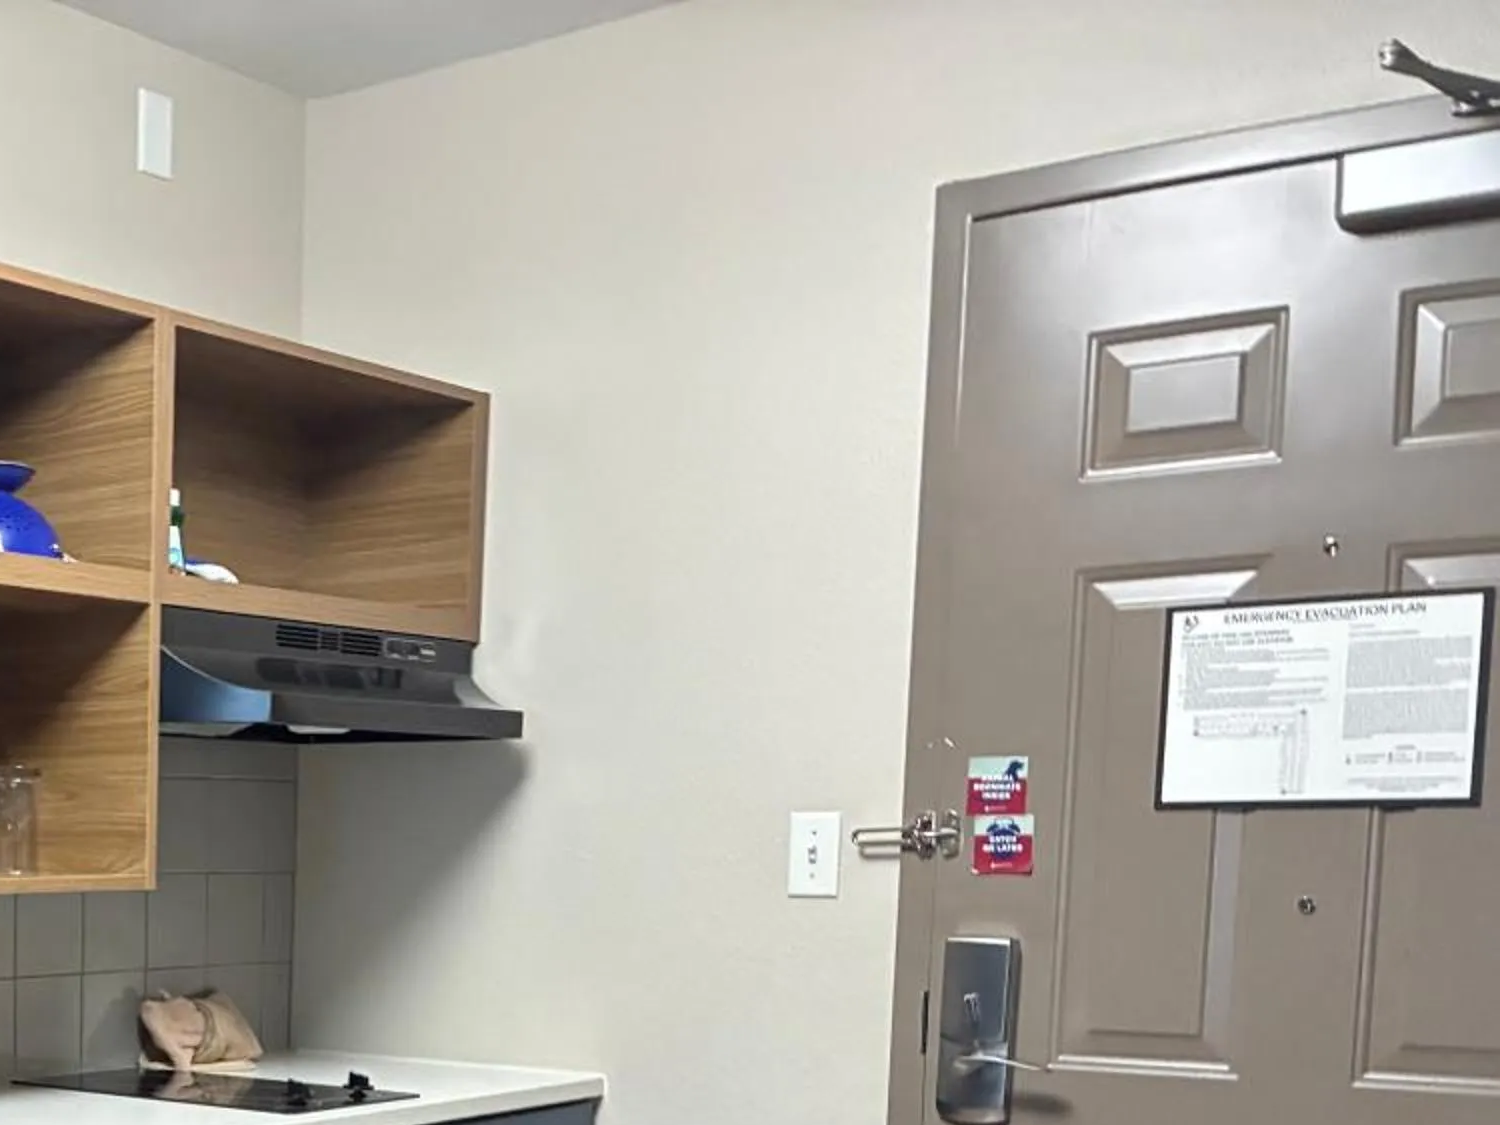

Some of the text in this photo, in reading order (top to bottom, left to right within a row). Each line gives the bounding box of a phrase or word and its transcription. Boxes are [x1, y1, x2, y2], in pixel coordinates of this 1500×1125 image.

[1224, 600, 1427, 624] EMERGENCY EVACUATION PLAN
